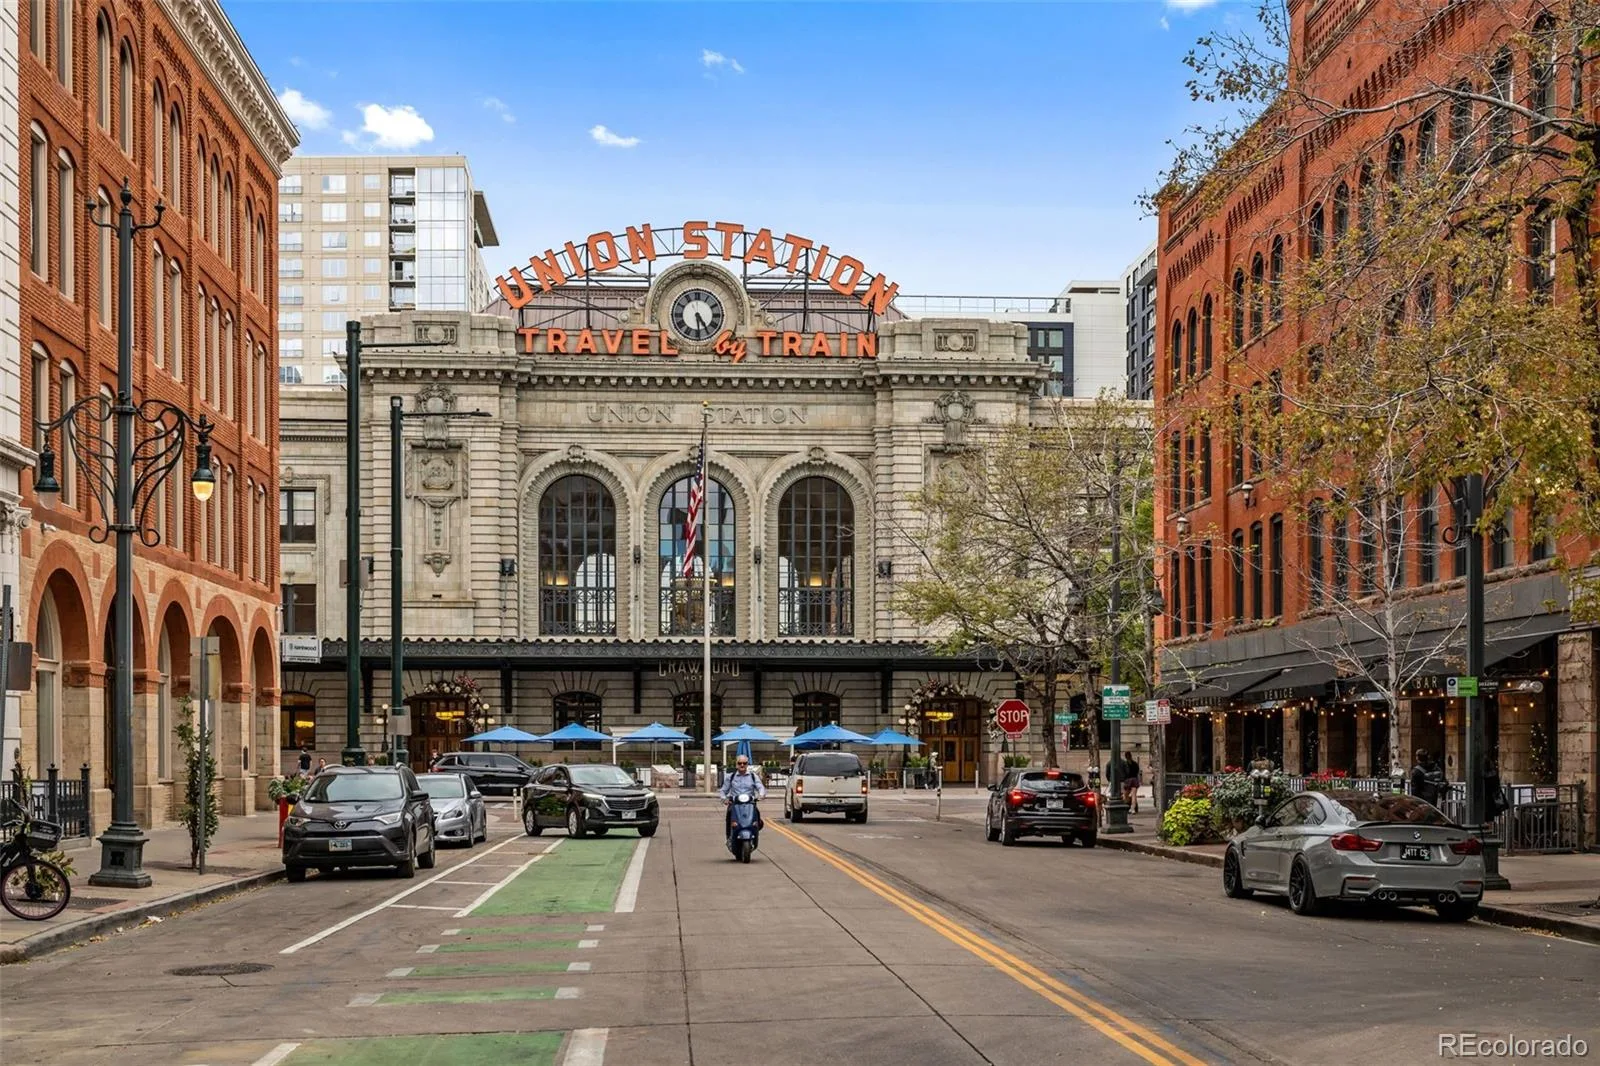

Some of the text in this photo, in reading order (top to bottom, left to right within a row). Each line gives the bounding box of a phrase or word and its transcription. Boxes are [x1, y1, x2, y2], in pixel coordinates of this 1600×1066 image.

[495, 221, 900, 316] UNION STATION
[517, 328, 877, 363] TRAVEL by TRAIN
[586, 405, 807, 424] UNION STATION
[658, 659, 740, 677] CRAWORD
[1264, 687, 1294, 700] VENICE
[999, 709, 1030, 723] STOP
